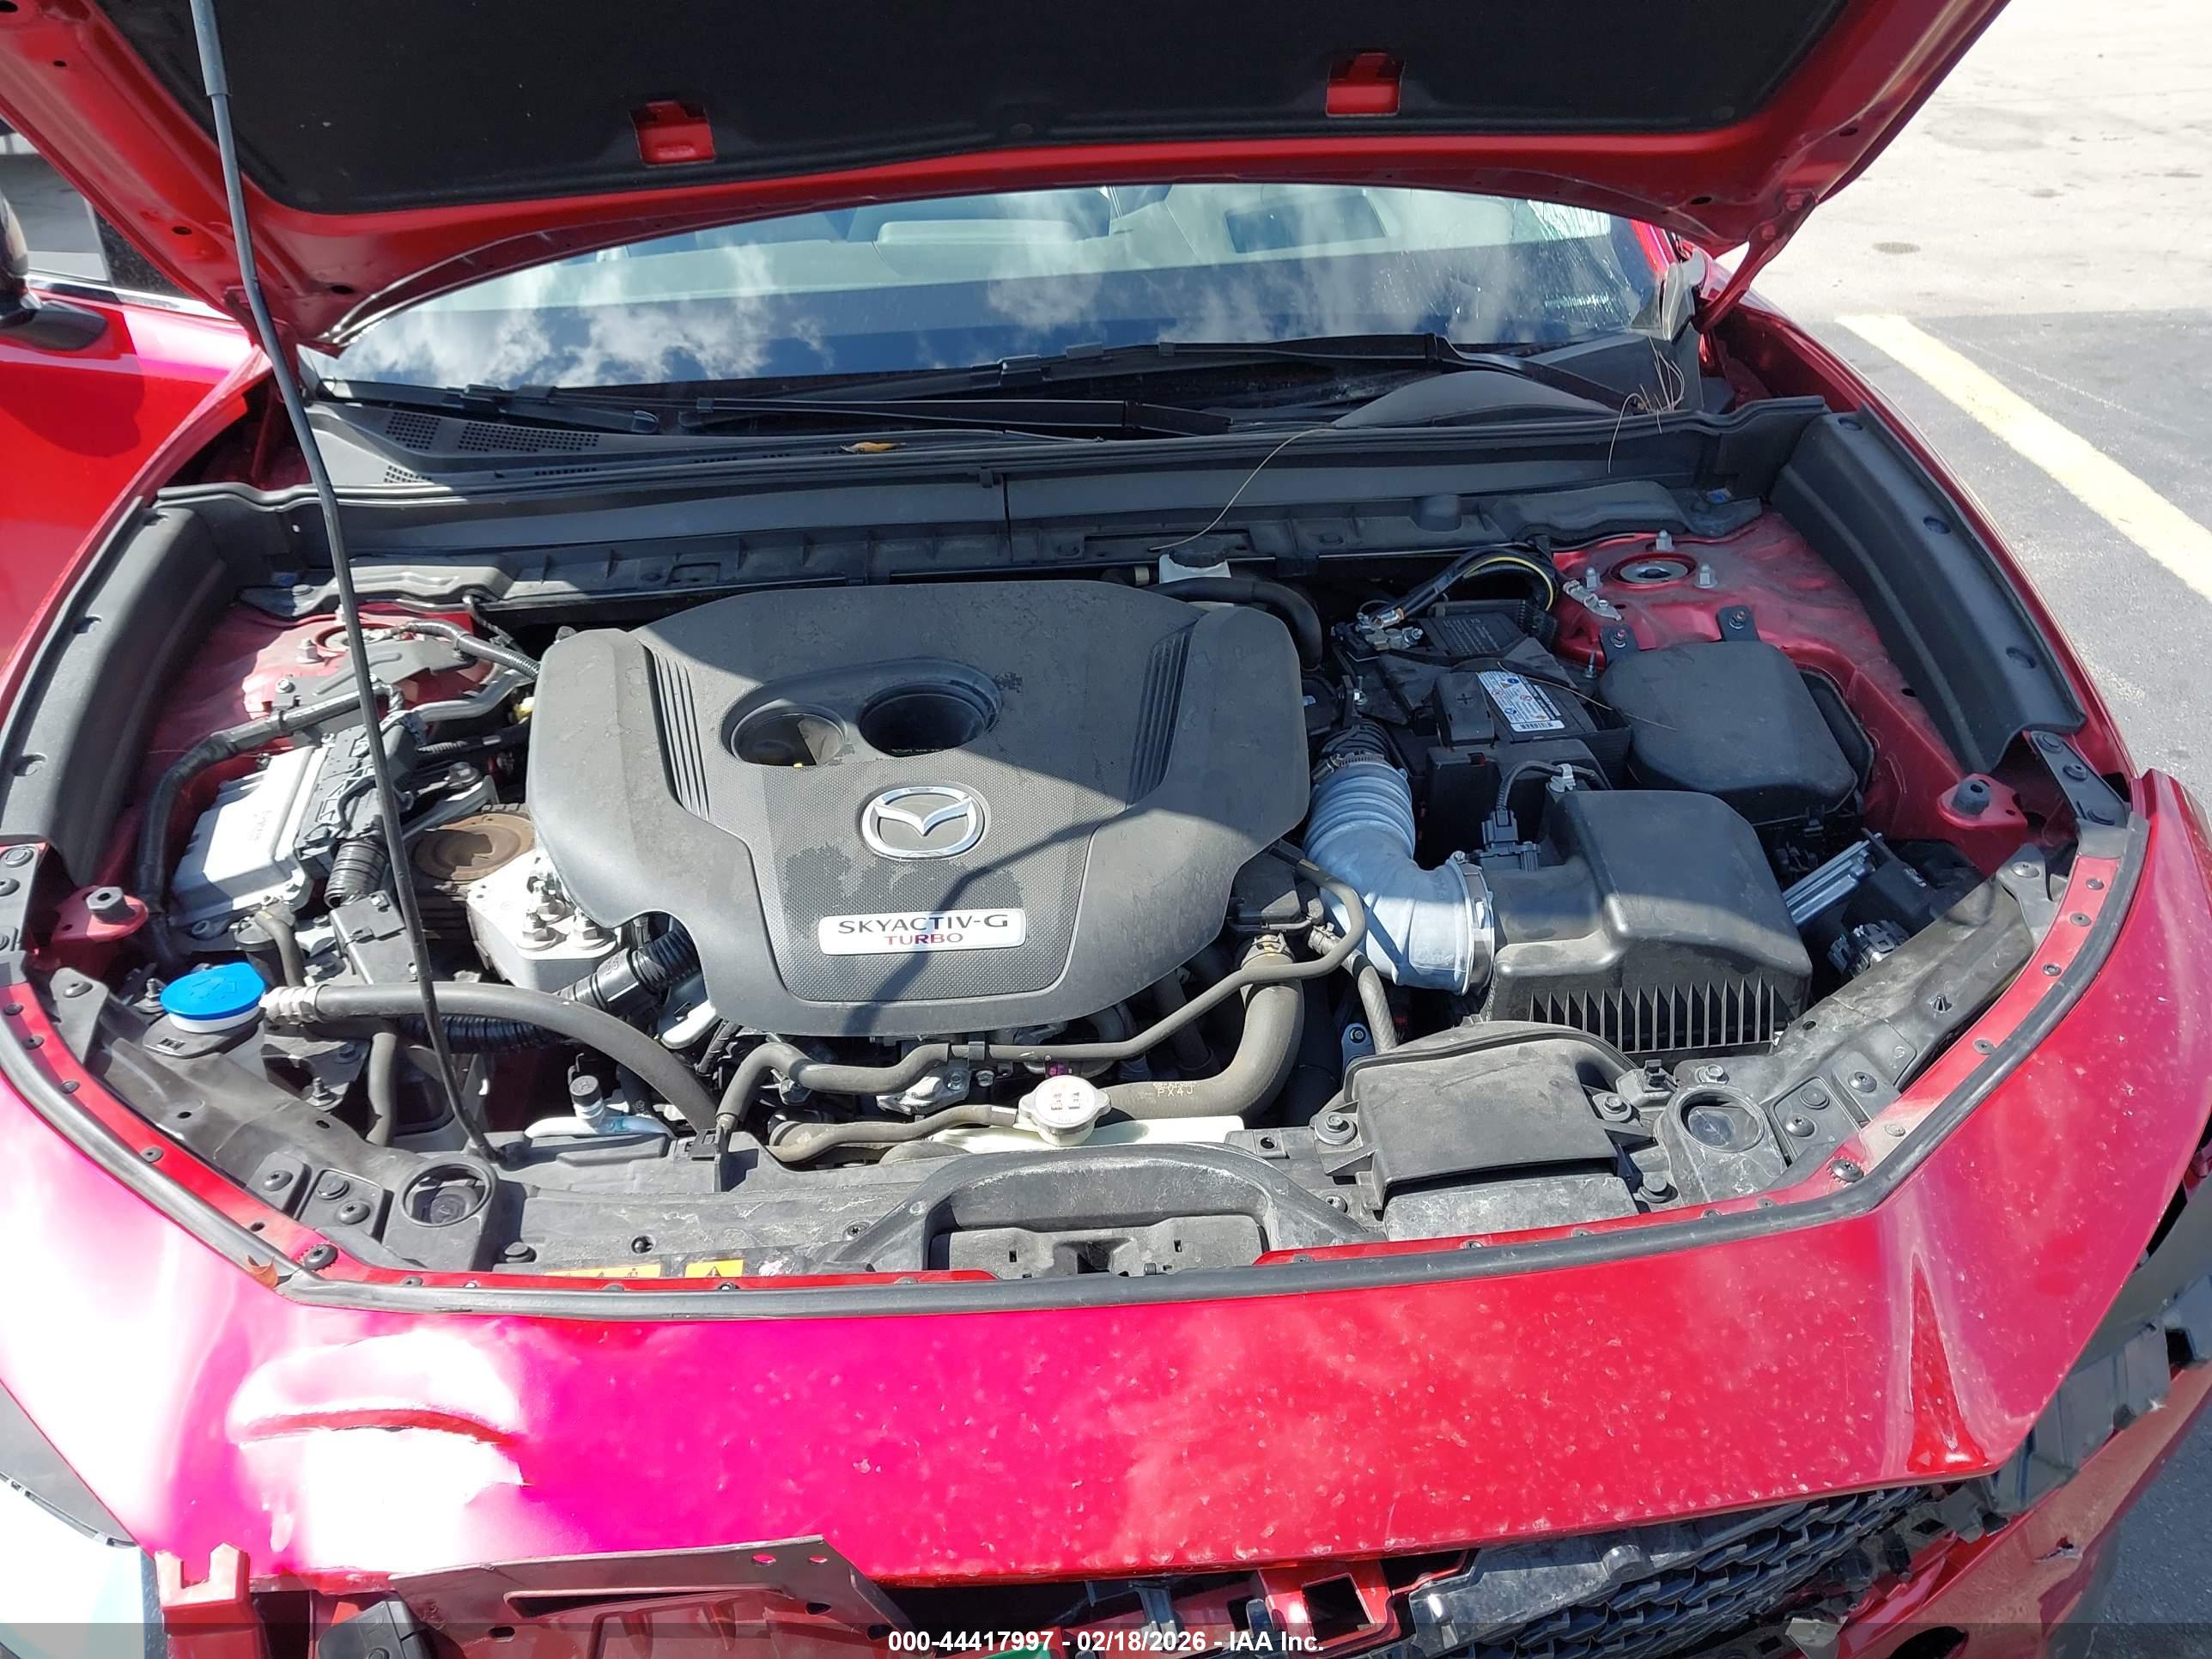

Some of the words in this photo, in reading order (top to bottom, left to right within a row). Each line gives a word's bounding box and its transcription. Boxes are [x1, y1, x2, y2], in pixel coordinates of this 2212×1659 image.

[838, 915, 1008, 934] SKYACTIV-G
[884, 933, 963, 945] TURBO
[1157, 1085, 1194, 1097] PX4J
